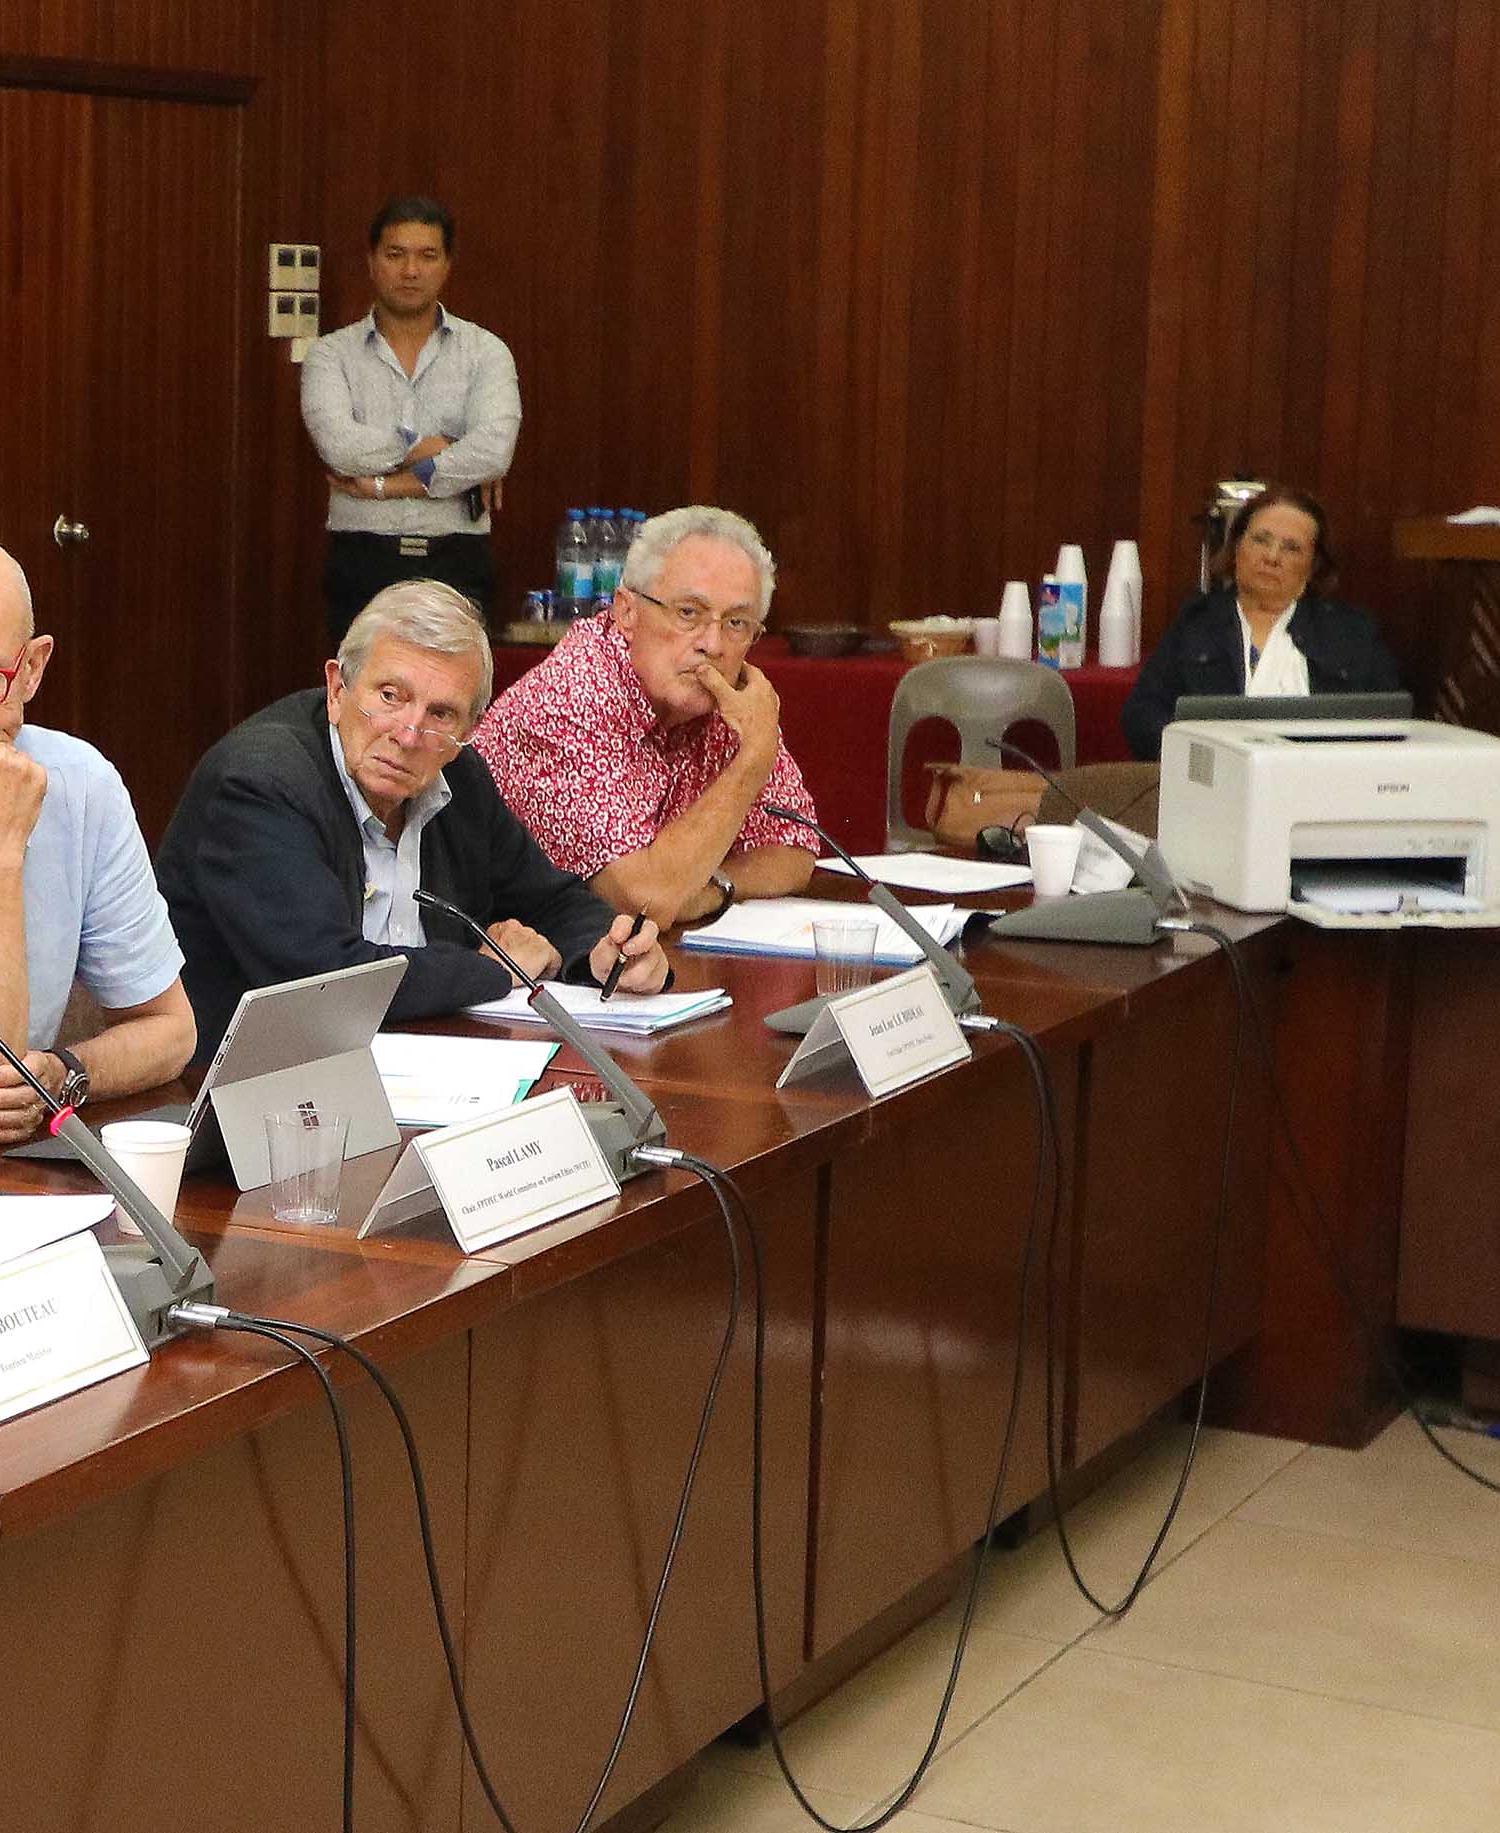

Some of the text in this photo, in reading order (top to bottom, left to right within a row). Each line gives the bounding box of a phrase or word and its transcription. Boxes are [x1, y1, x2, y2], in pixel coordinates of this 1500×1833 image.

[1377, 783, 1411, 794] EPSON
[486, 1140, 543, 1172] Pascal LAMY
